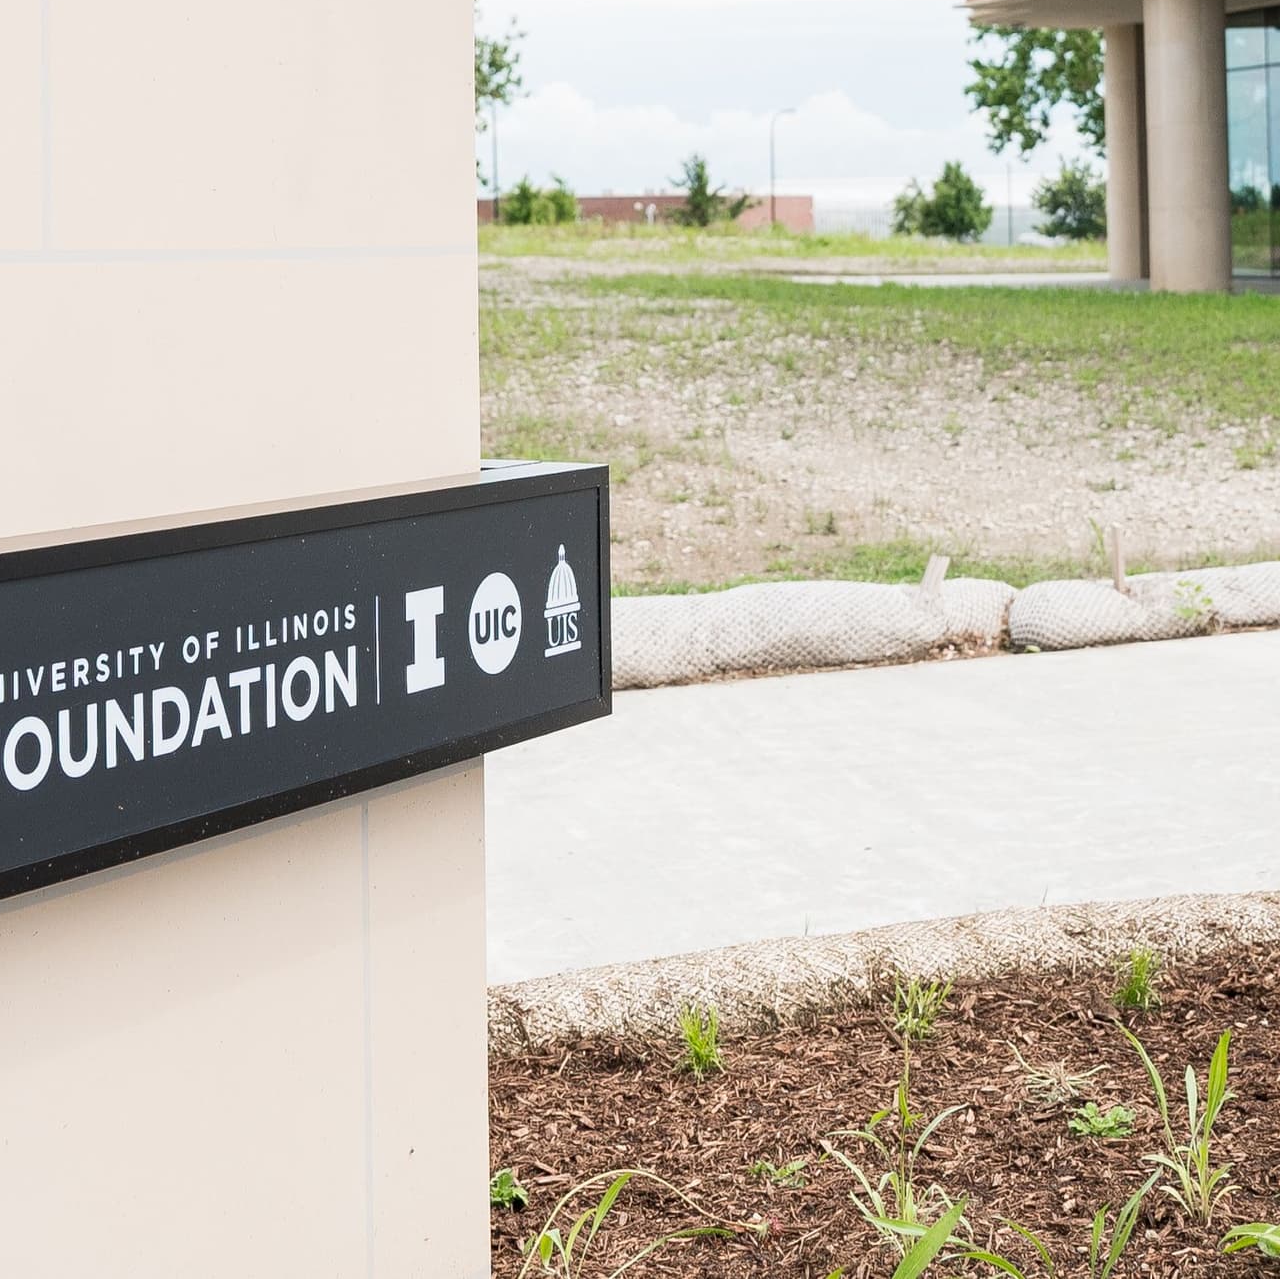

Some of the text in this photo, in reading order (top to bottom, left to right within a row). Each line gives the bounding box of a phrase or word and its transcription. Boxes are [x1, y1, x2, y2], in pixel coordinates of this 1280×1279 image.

[182, 630, 220, 665] OF
[236, 603, 357, 654] ILLINOIS
[405, 585, 446, 695] I
[474, 604, 517, 645] UIC
[546, 611, 579, 647] UIS
